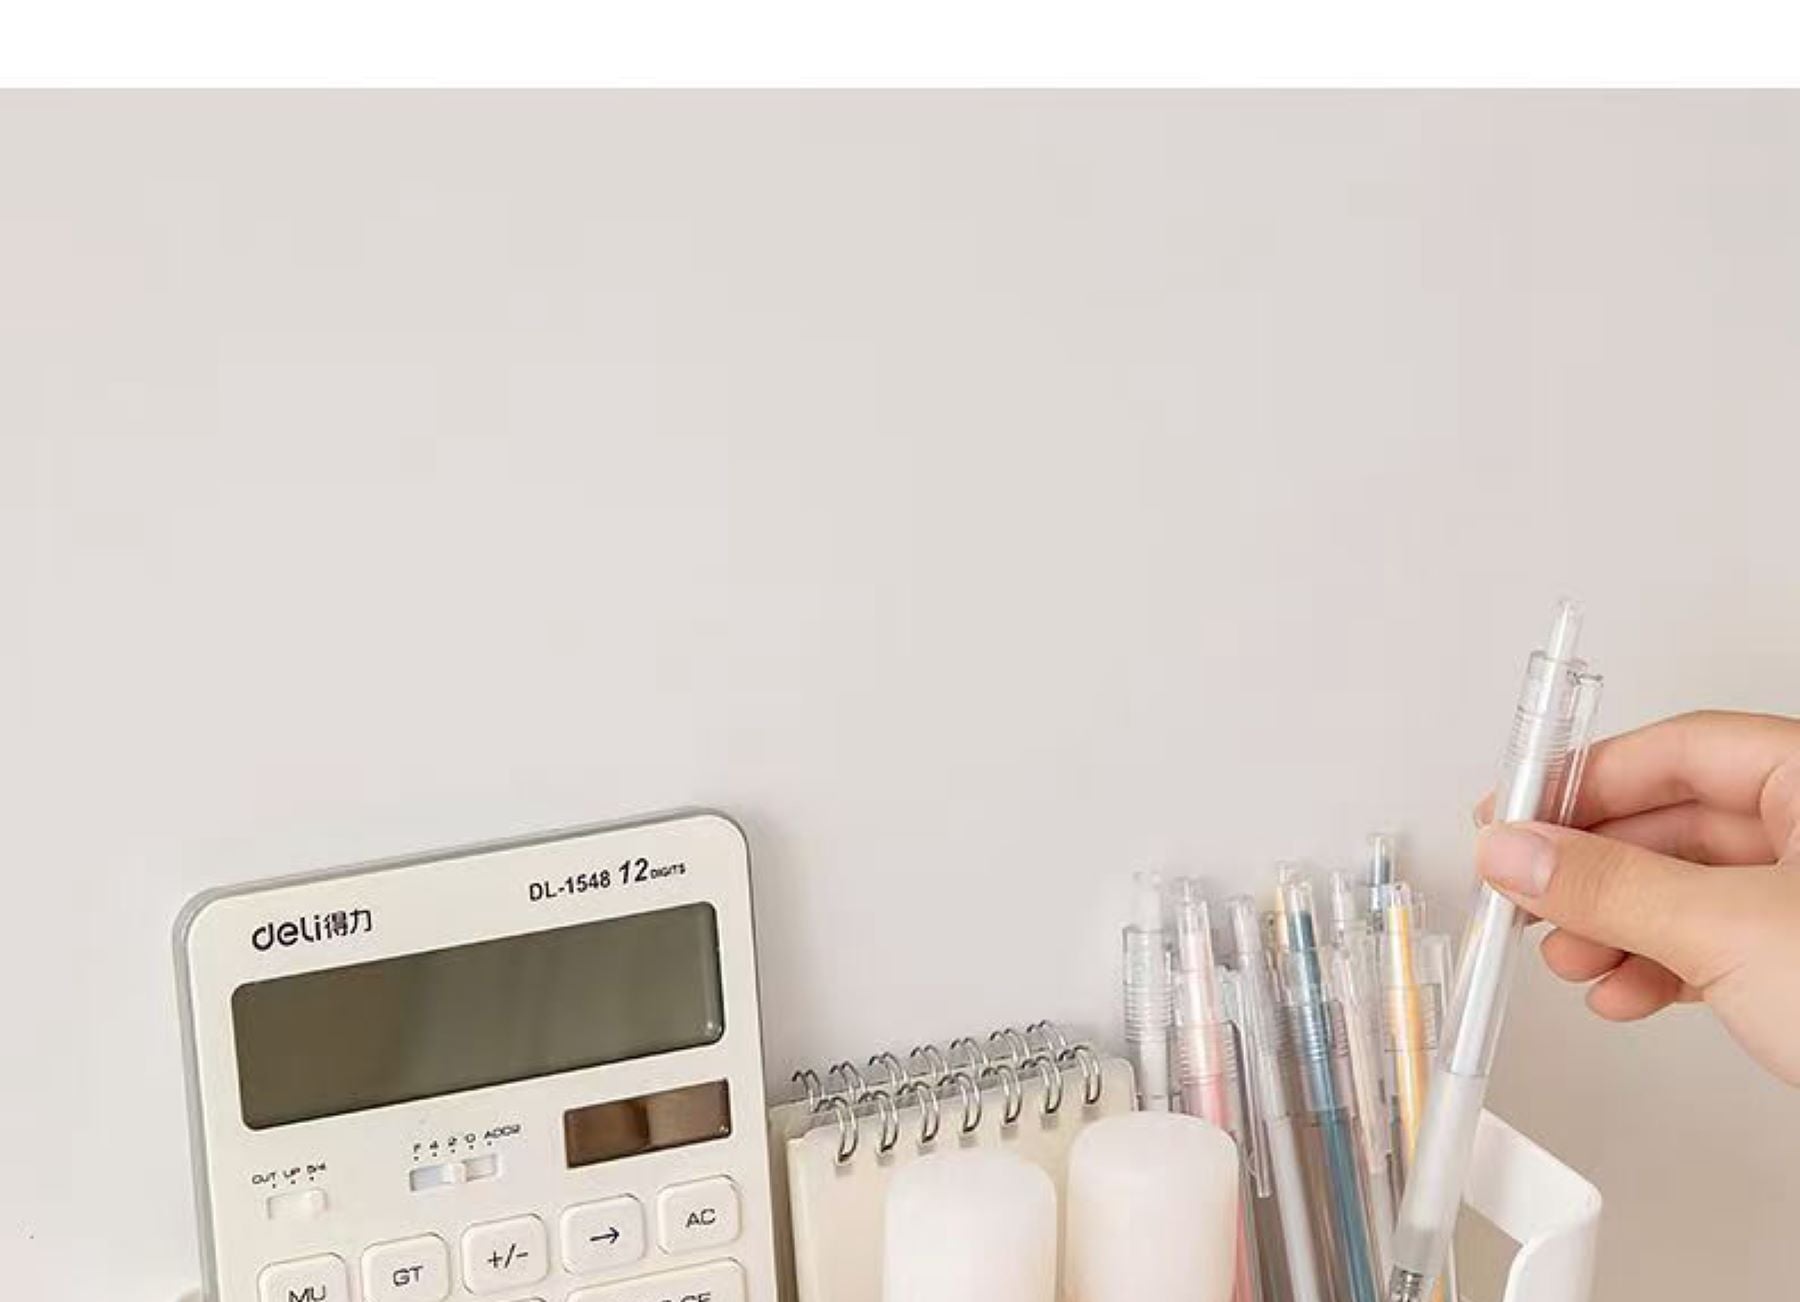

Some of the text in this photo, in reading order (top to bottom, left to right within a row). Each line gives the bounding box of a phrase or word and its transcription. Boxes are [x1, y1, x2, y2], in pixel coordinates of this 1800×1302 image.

[530, 868, 611, 902] DL-1548
[685, 1208, 717, 1228] AC
[392, 1264, 425, 1287] GT
